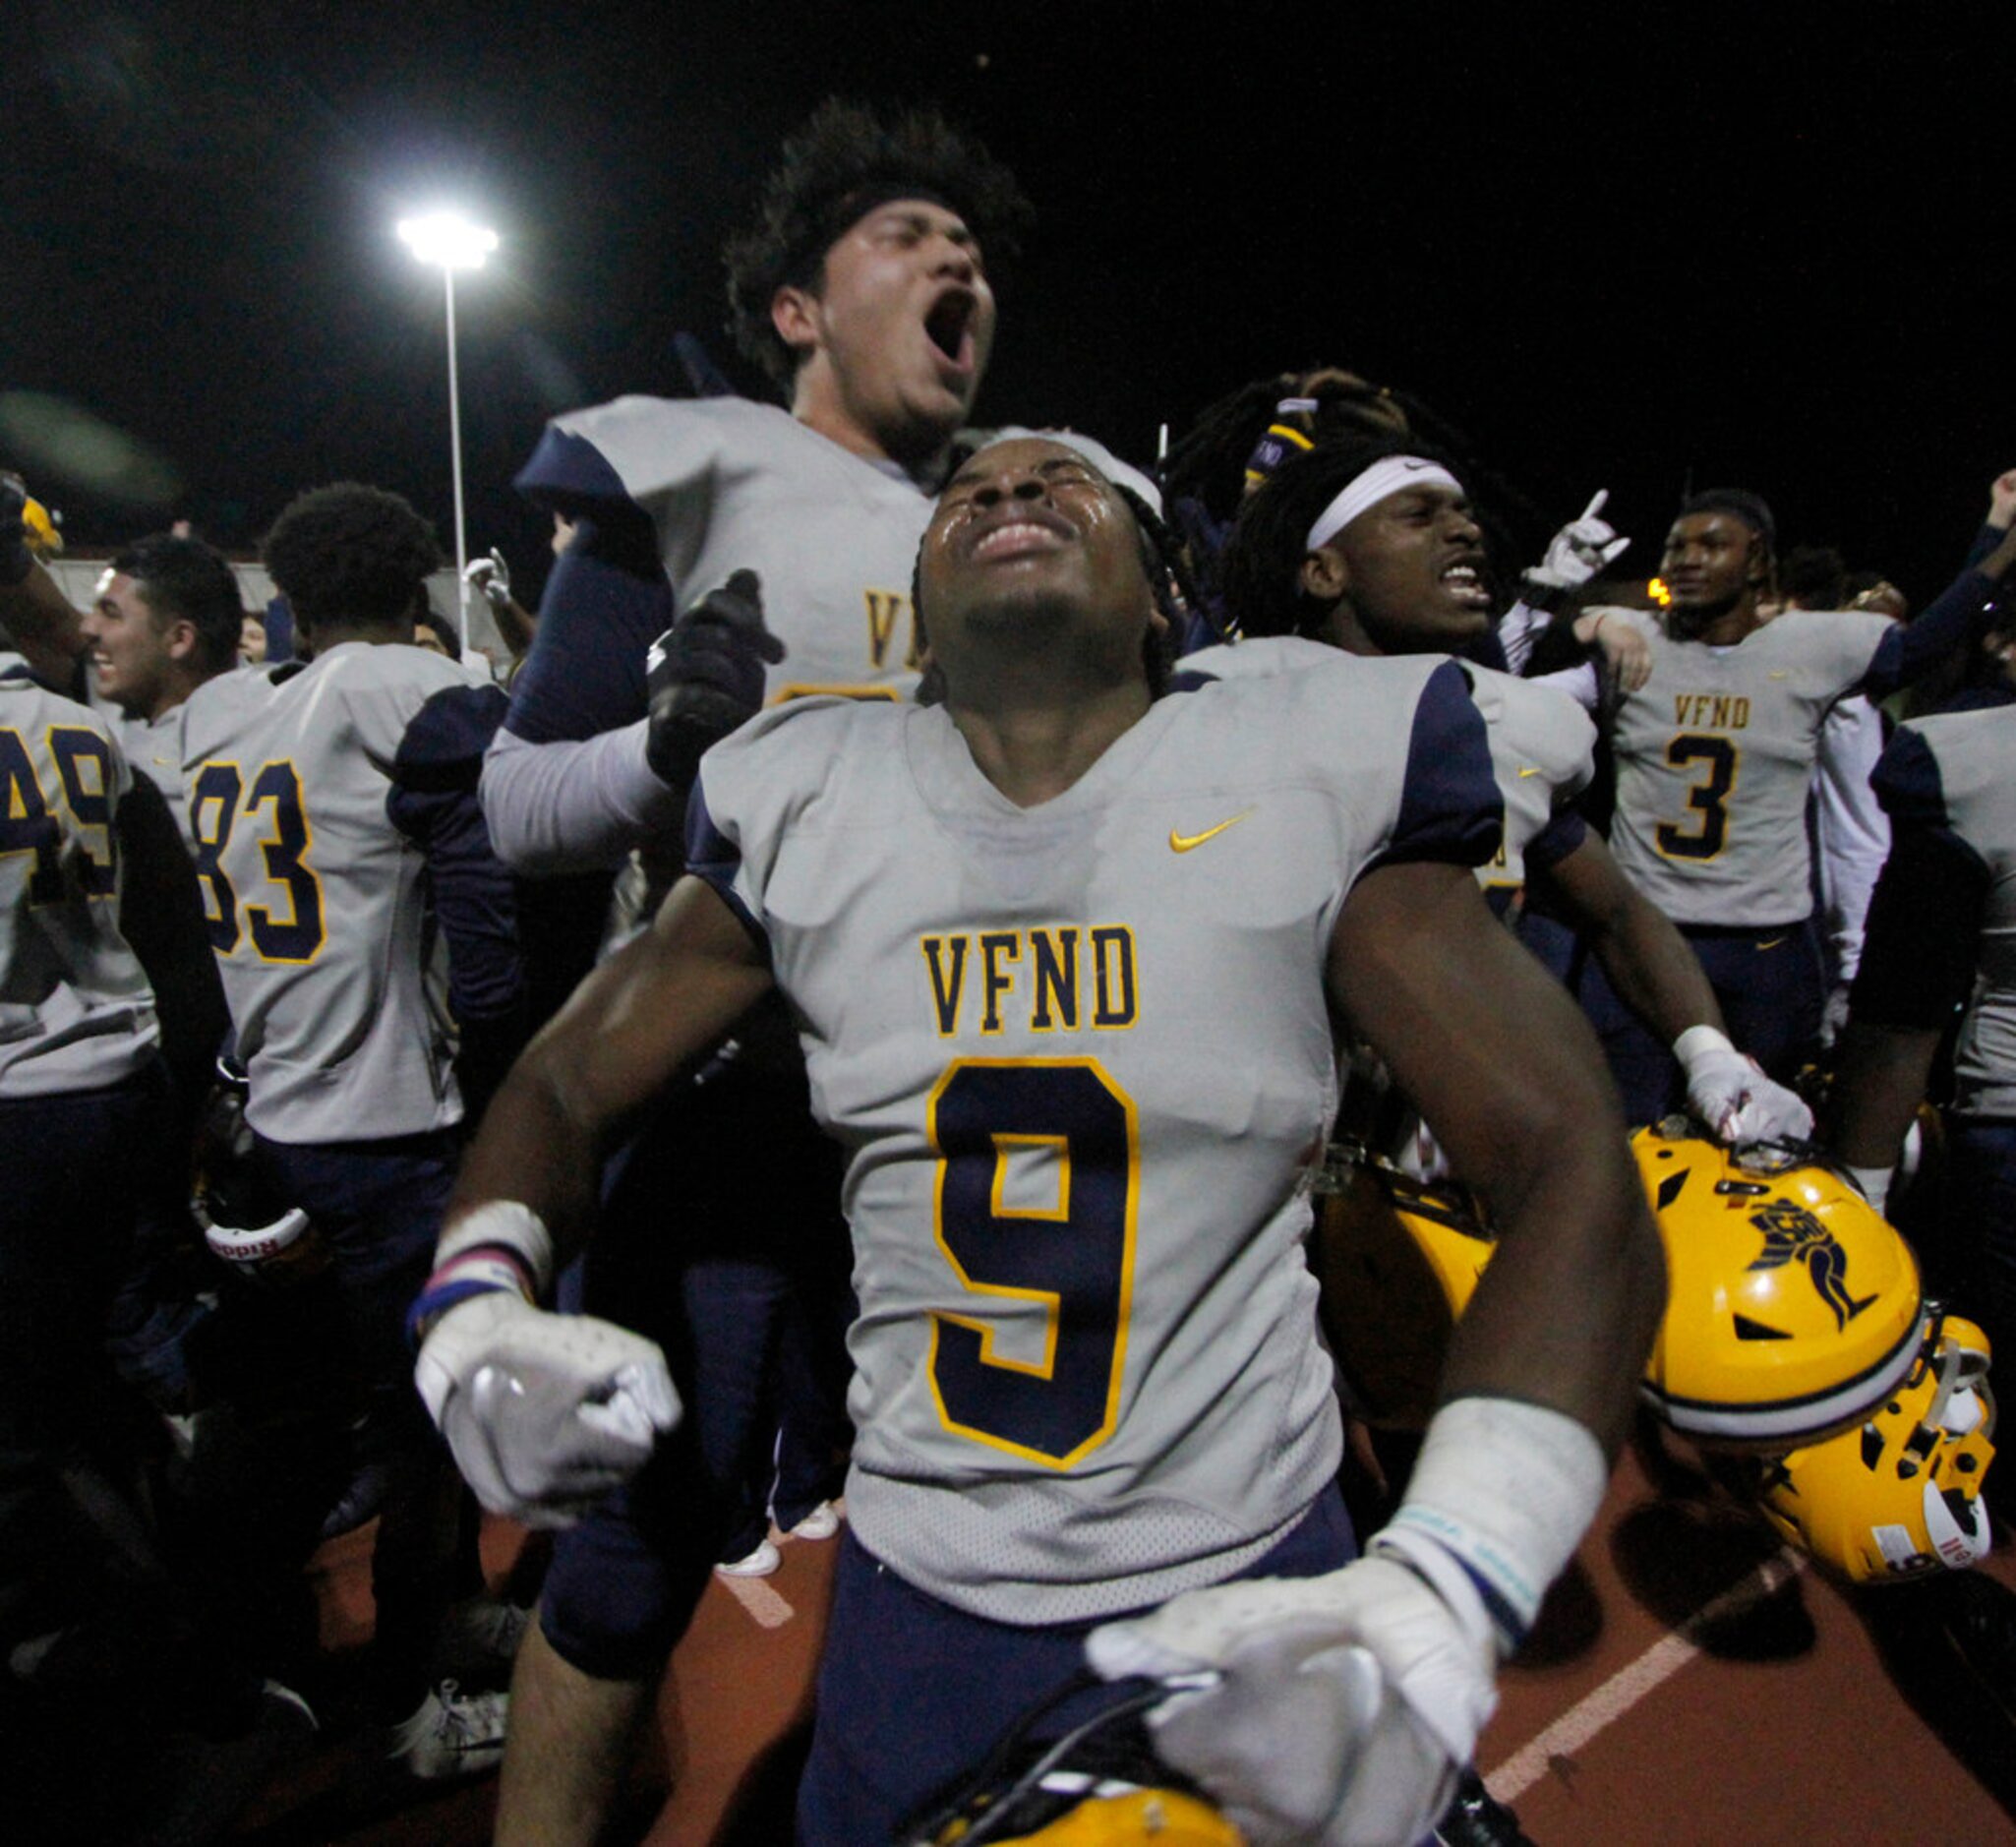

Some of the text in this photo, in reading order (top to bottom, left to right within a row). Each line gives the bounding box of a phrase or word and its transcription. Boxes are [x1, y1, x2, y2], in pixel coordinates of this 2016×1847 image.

[1676, 694, 1749, 729] VFND
[190, 759, 326, 965] 83
[1655, 734, 1738, 863] 3
[922, 926, 1138, 1037] VFND
[927, 1057, 1139, 1470] 9
